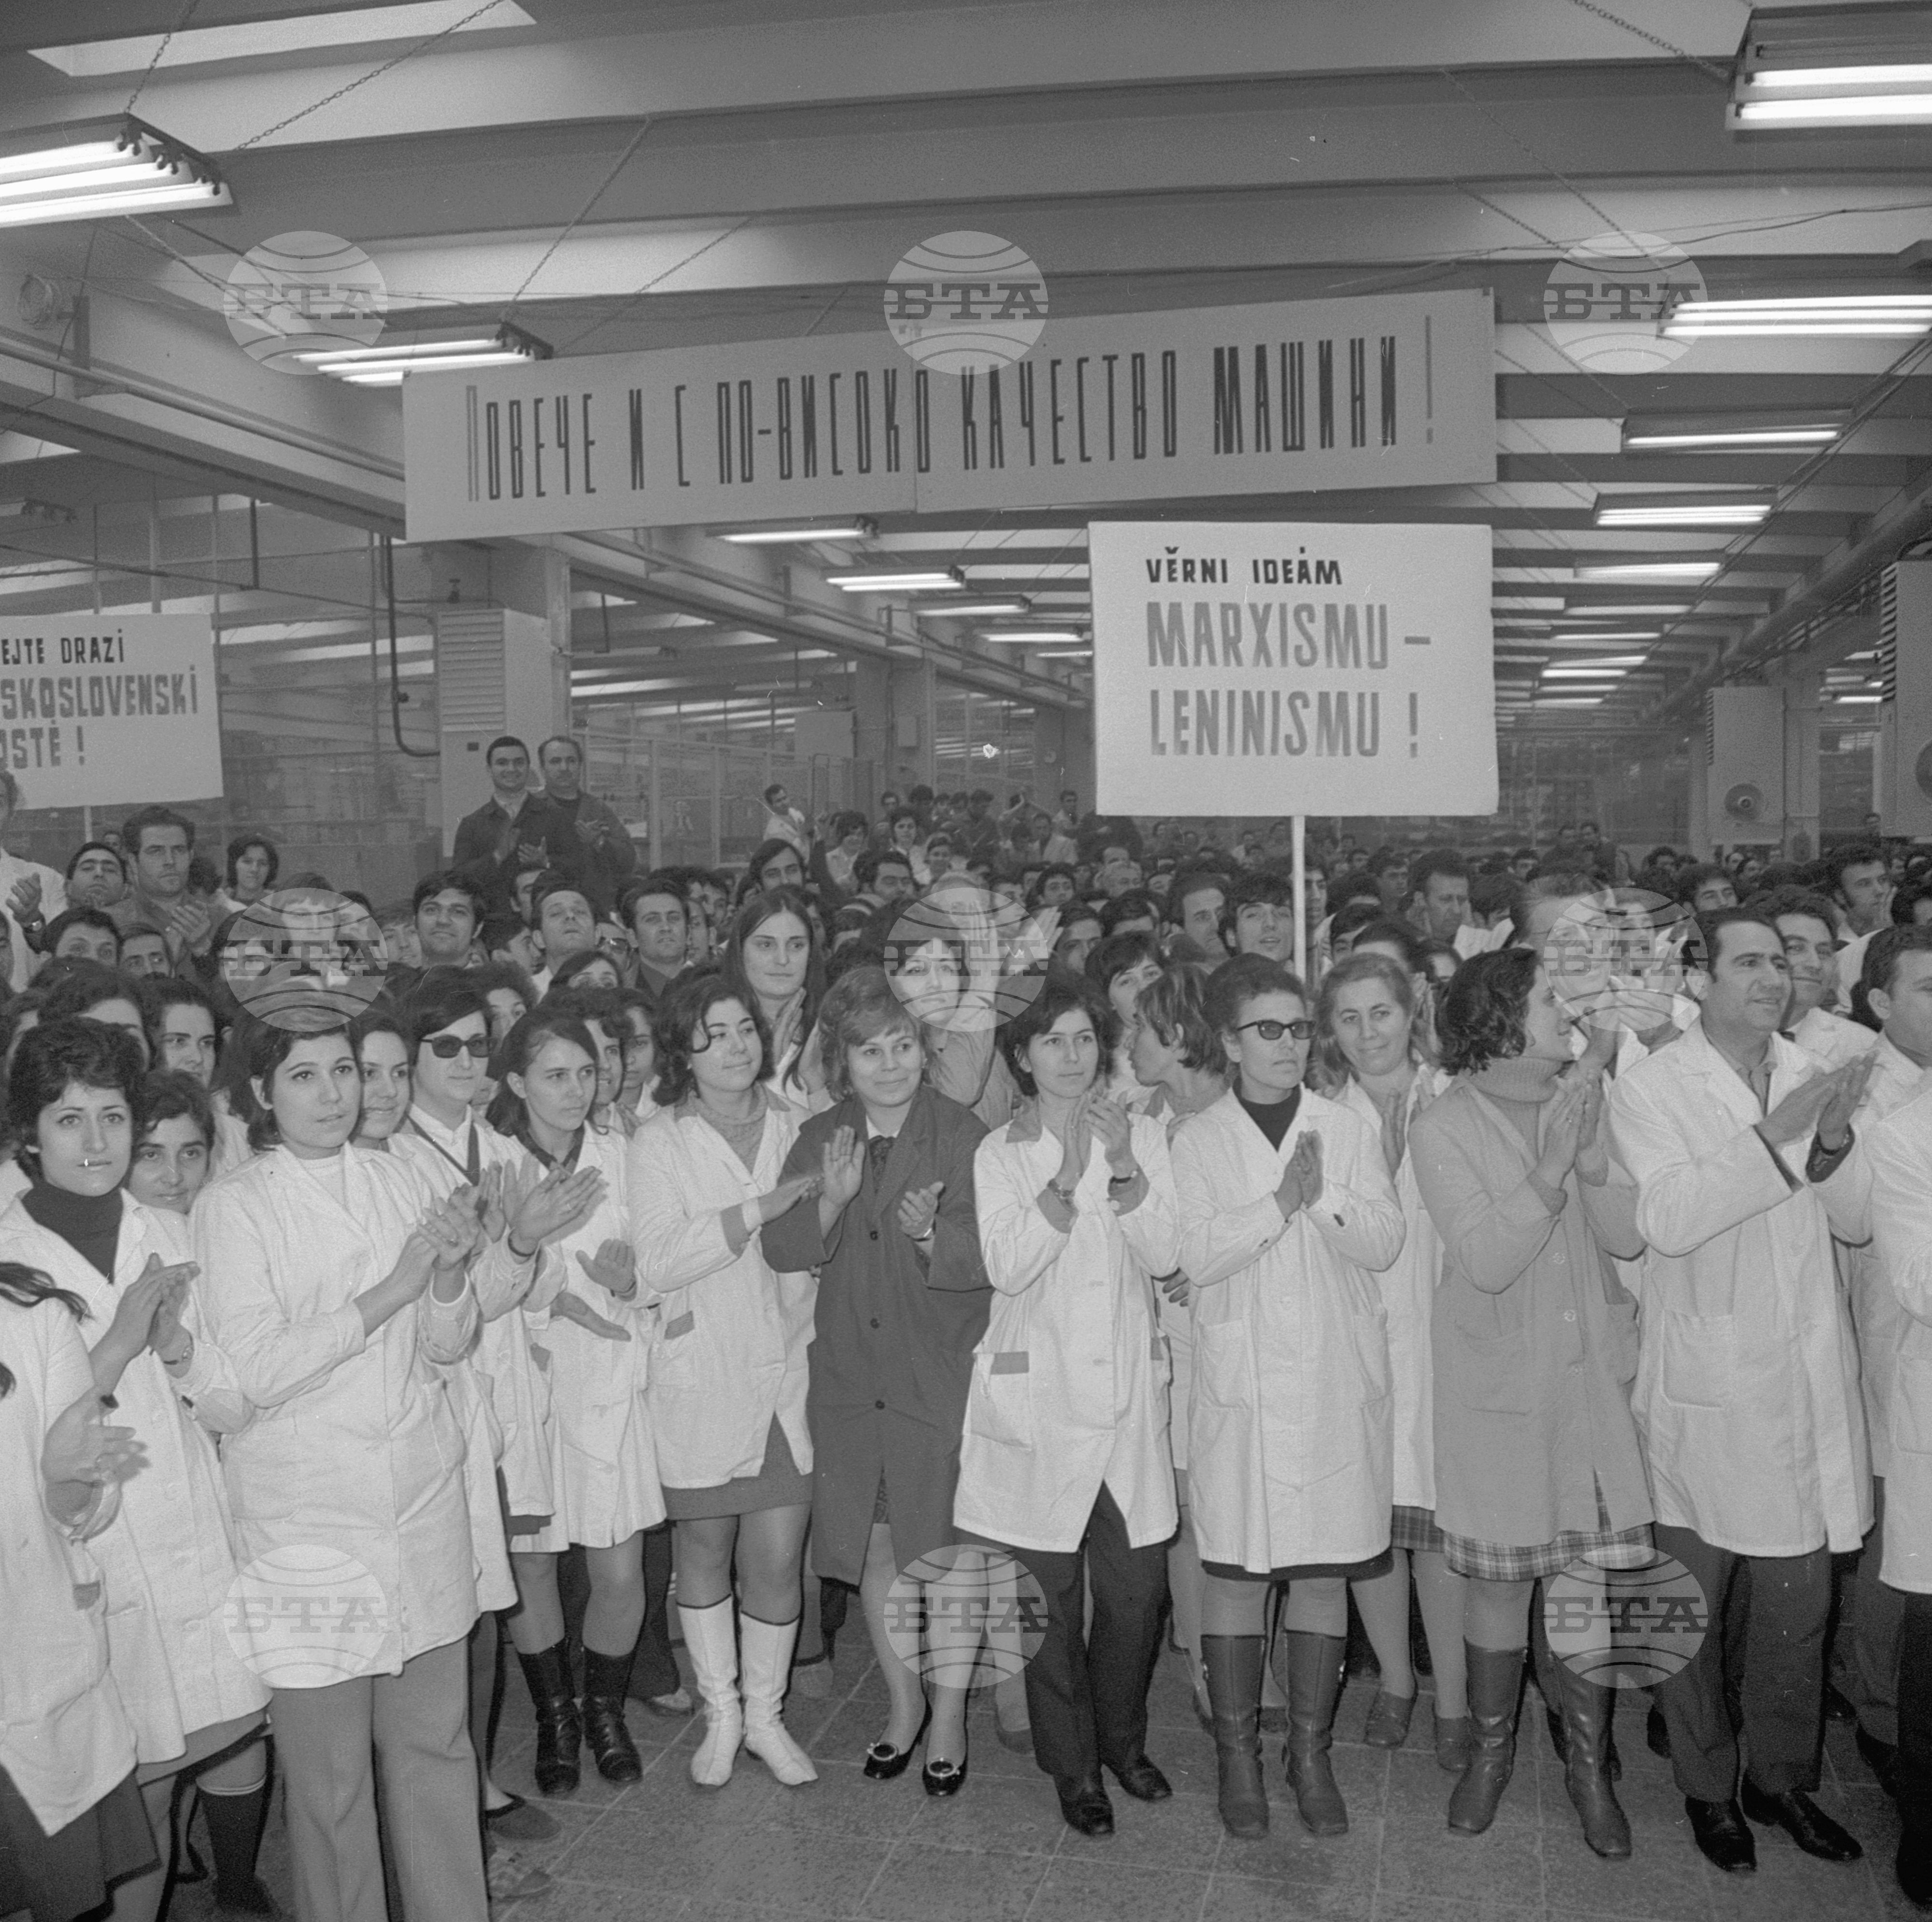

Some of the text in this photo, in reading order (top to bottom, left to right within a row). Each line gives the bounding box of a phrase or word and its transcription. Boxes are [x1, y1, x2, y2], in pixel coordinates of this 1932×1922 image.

[466, 385, 596, 502] ПОВЕЧЕ
[629, 388, 644, 490] И
[677, 385, 690, 487] С
[717, 368, 930, 484] ПО-ВИСОКО
[962, 350, 1177, 470] КАЧЕСТВО
[1214, 336, 1396, 455] МАШИНИ
[1146, 546, 1228, 583] VĚRNI
[1150, 689, 1379, 758] LENINISMU
